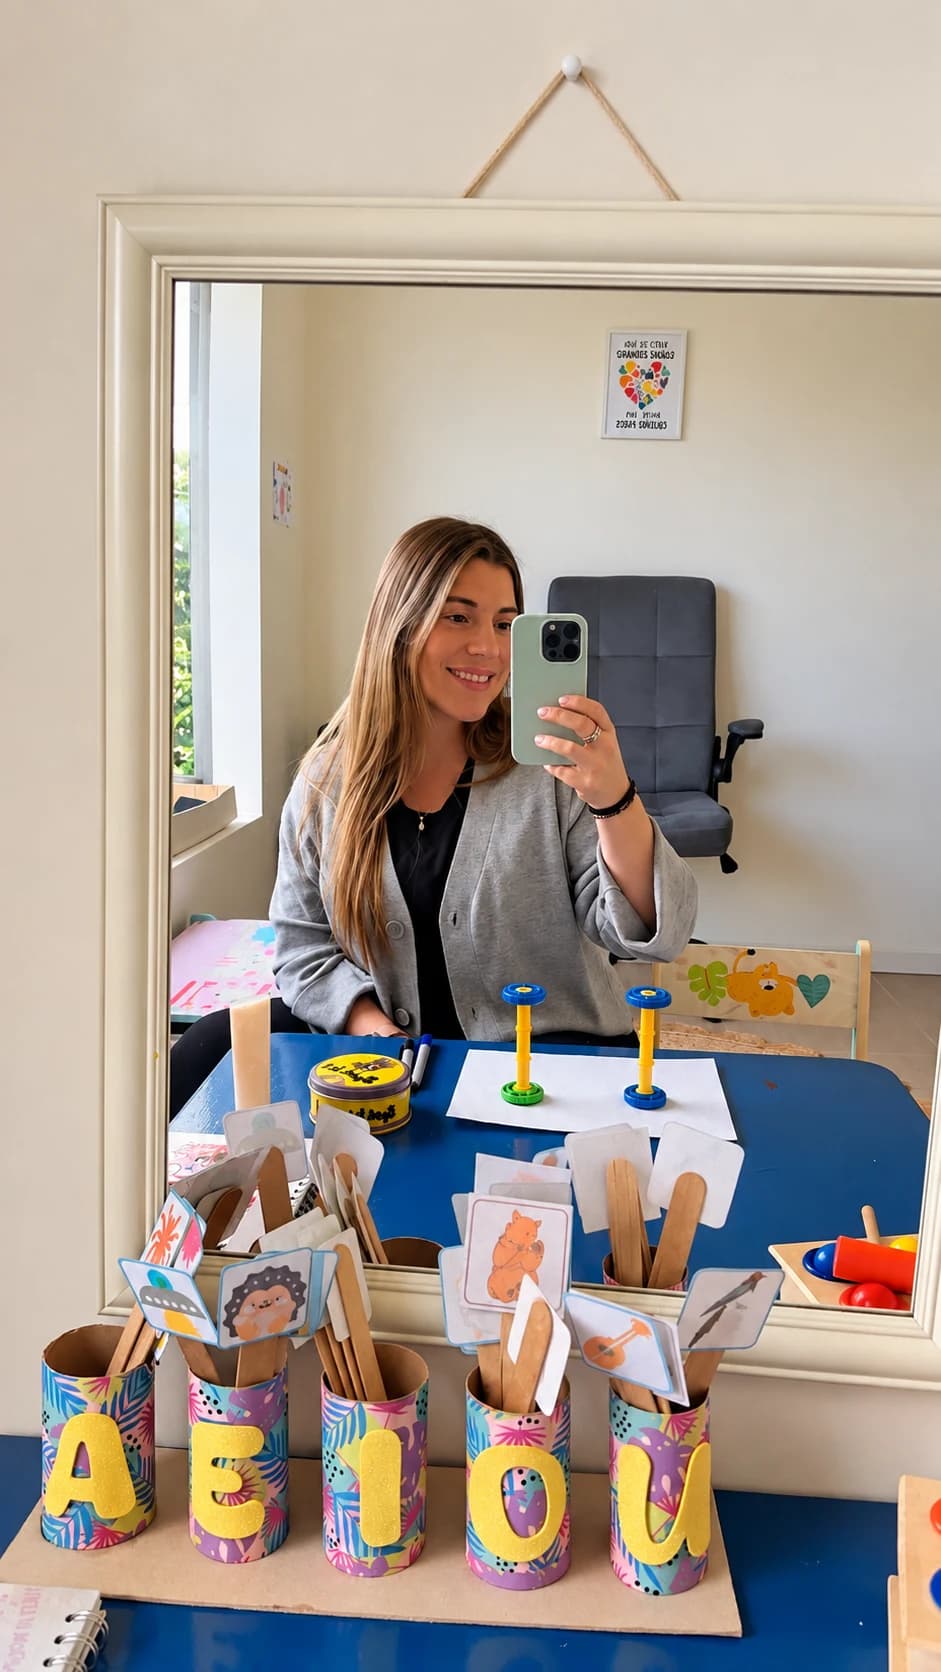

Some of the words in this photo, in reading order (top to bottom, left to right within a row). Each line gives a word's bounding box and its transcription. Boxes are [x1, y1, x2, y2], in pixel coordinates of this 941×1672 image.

[44, 1412, 136, 1519] A
[191, 1421, 265, 1539] E
[359, 1429, 402, 1547] I
[468, 1445, 567, 1562] O
